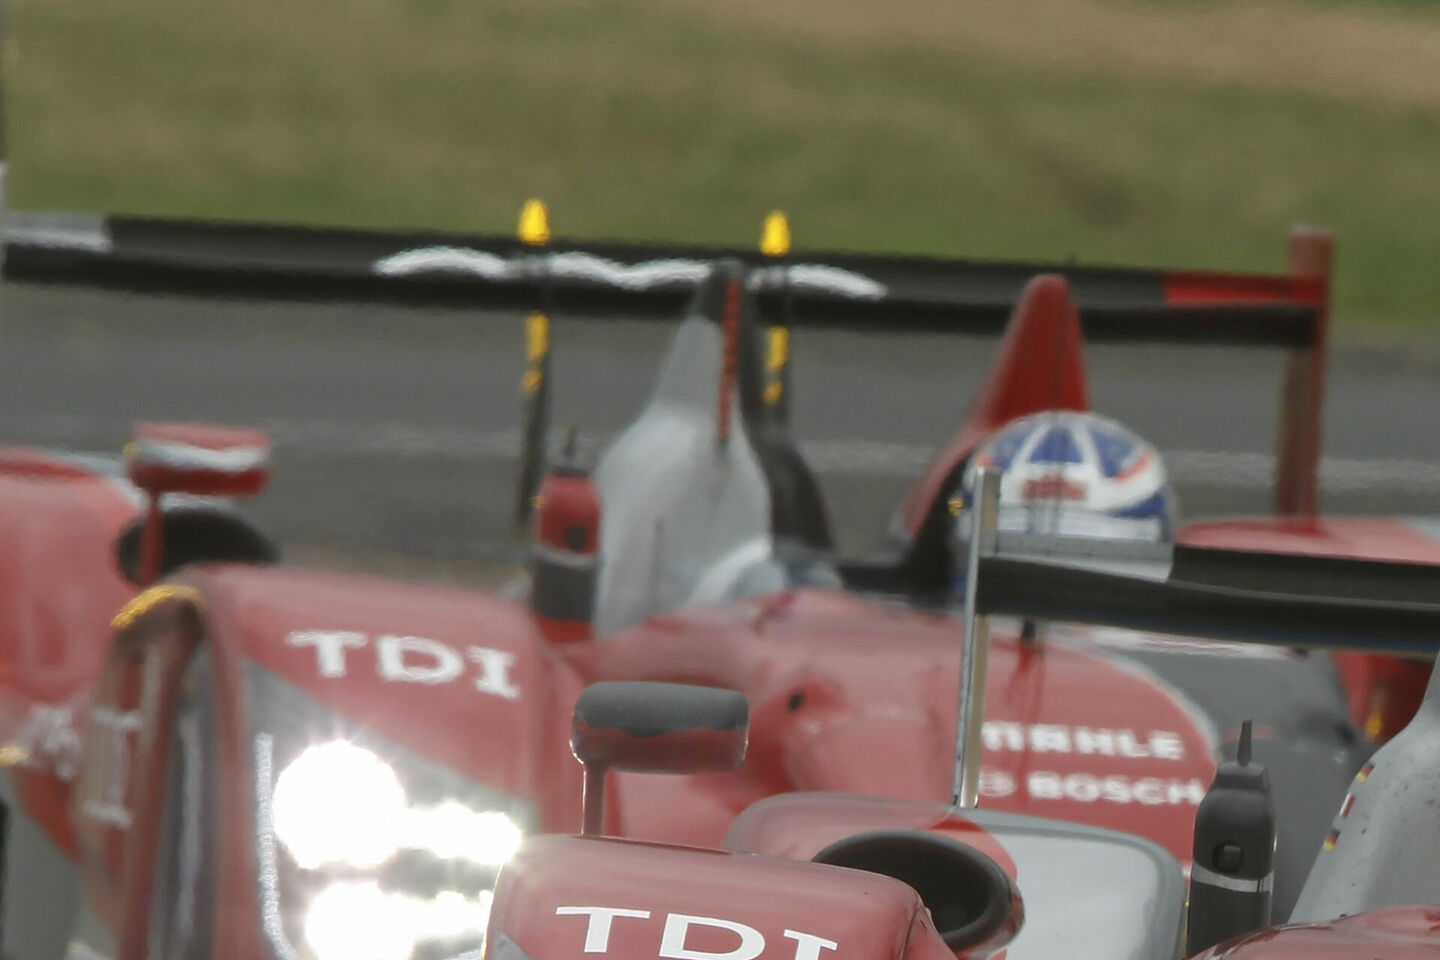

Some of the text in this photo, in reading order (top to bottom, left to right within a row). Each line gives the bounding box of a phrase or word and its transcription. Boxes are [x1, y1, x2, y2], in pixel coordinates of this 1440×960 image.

[286, 631, 520, 699] TDI
[981, 721, 1183, 760] MAHLE
[1027, 771, 1205, 805] BOSCH
